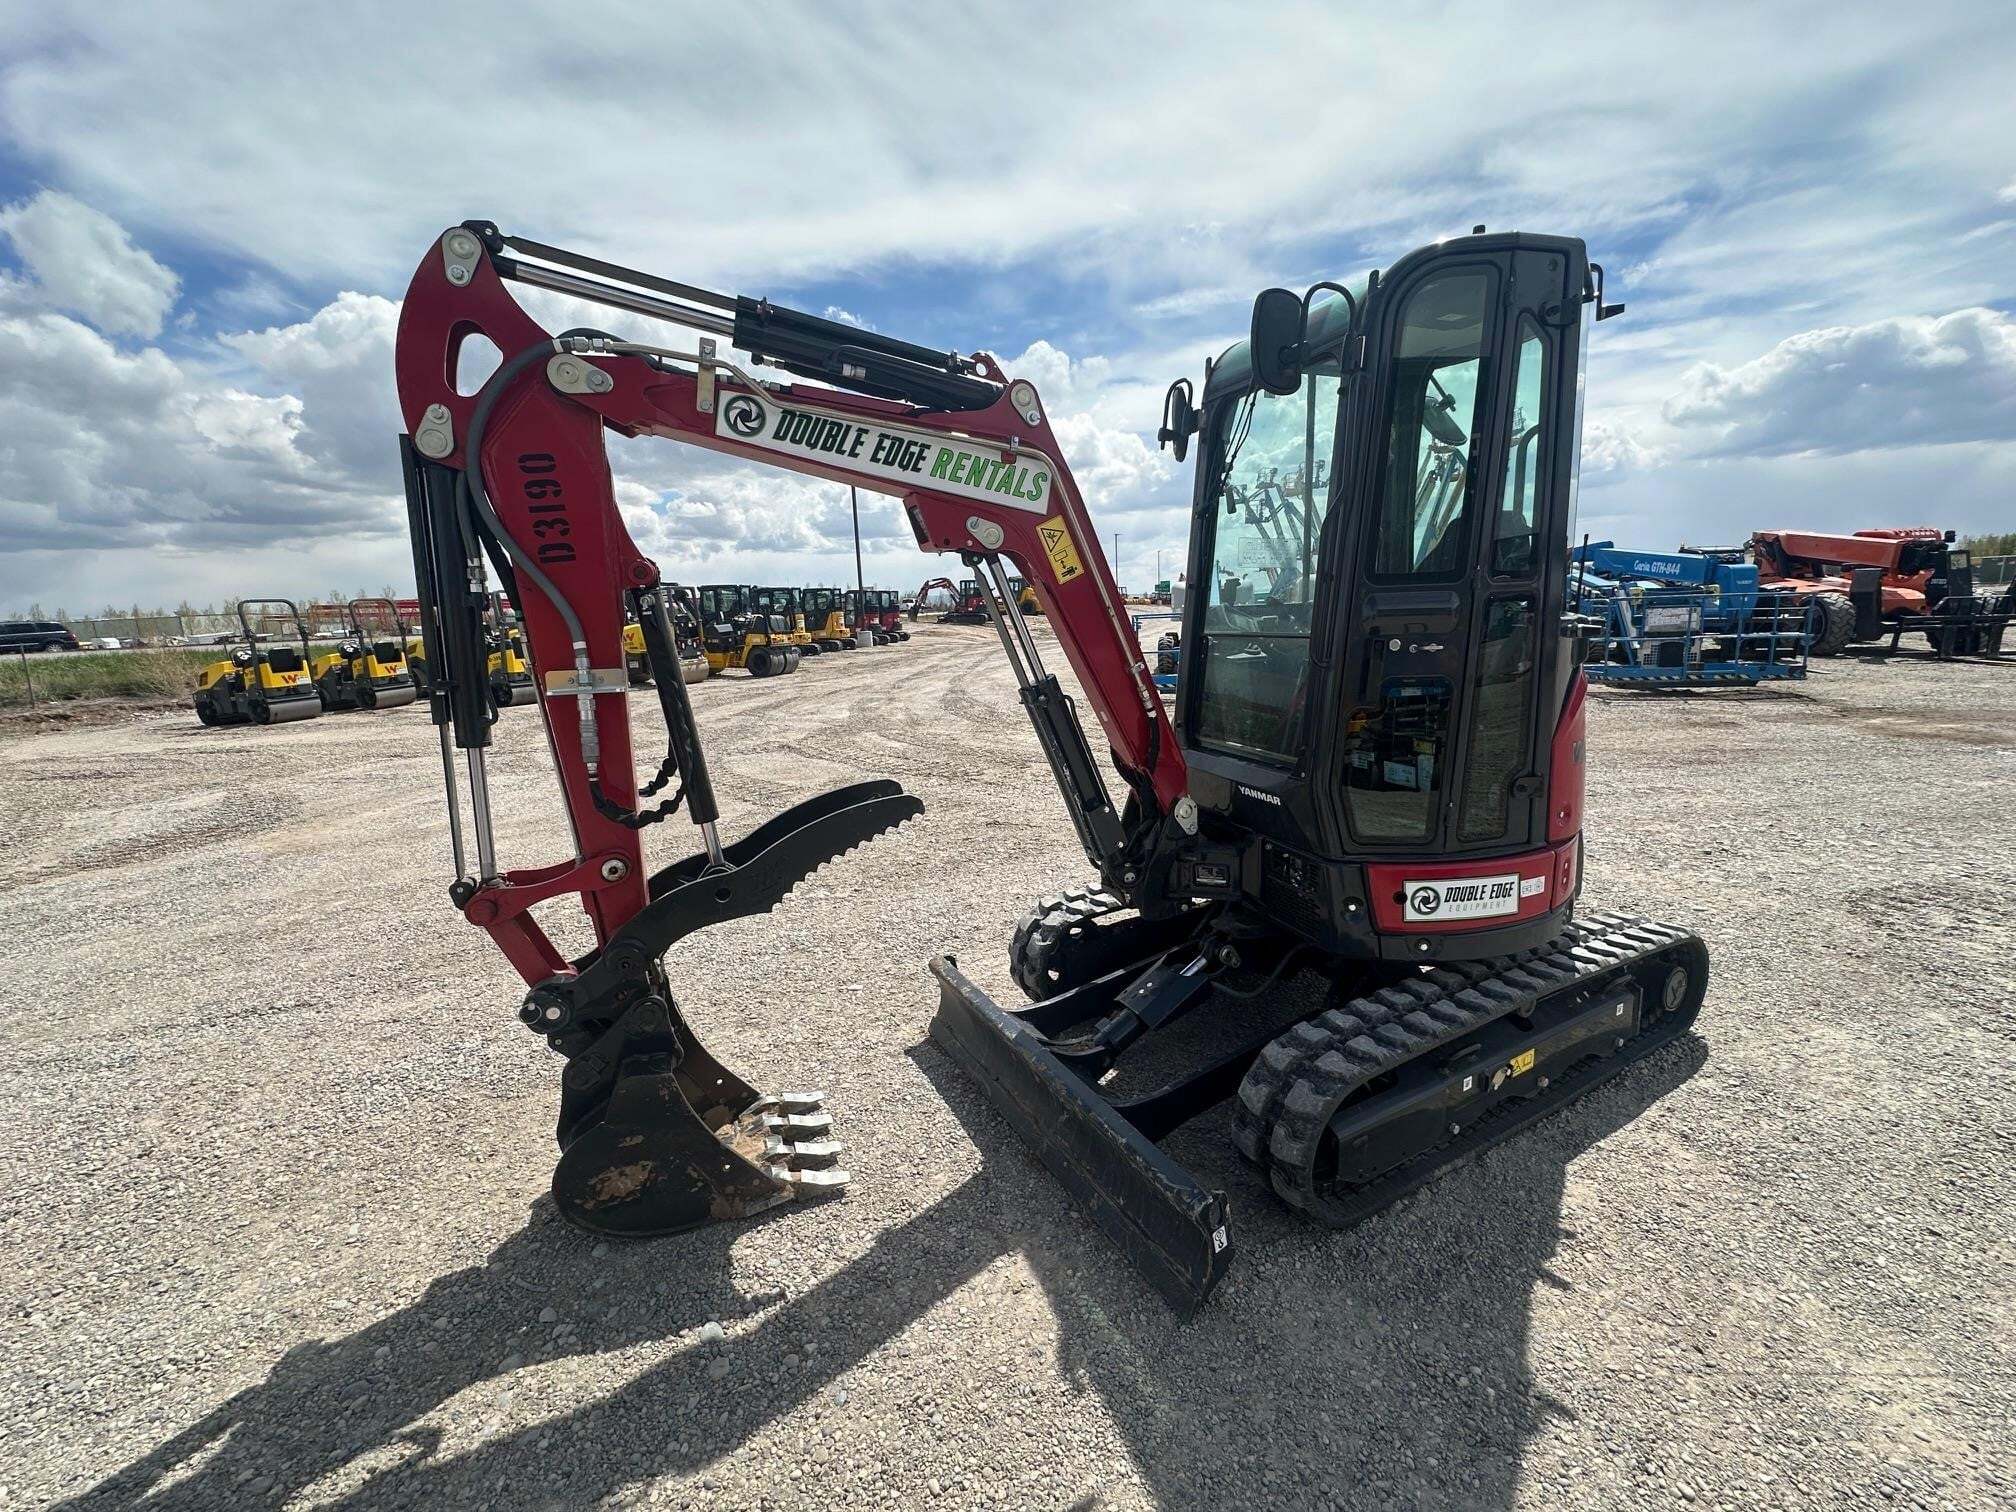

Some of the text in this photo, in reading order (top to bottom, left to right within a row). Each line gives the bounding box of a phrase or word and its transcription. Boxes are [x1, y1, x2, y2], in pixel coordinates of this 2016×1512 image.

[772, 408, 1048, 501] DOUBLE EDGE RENTALS
[518, 453, 576, 563] D3190
[1651, 561, 1681, 575] GTH-844
[1238, 785, 1281, 806] YANMAR
[1444, 883, 1488, 903] DOUBLE
[1489, 881, 1515, 899] EDGE
[1448, 900, 1507, 912] EQUIPMENT
